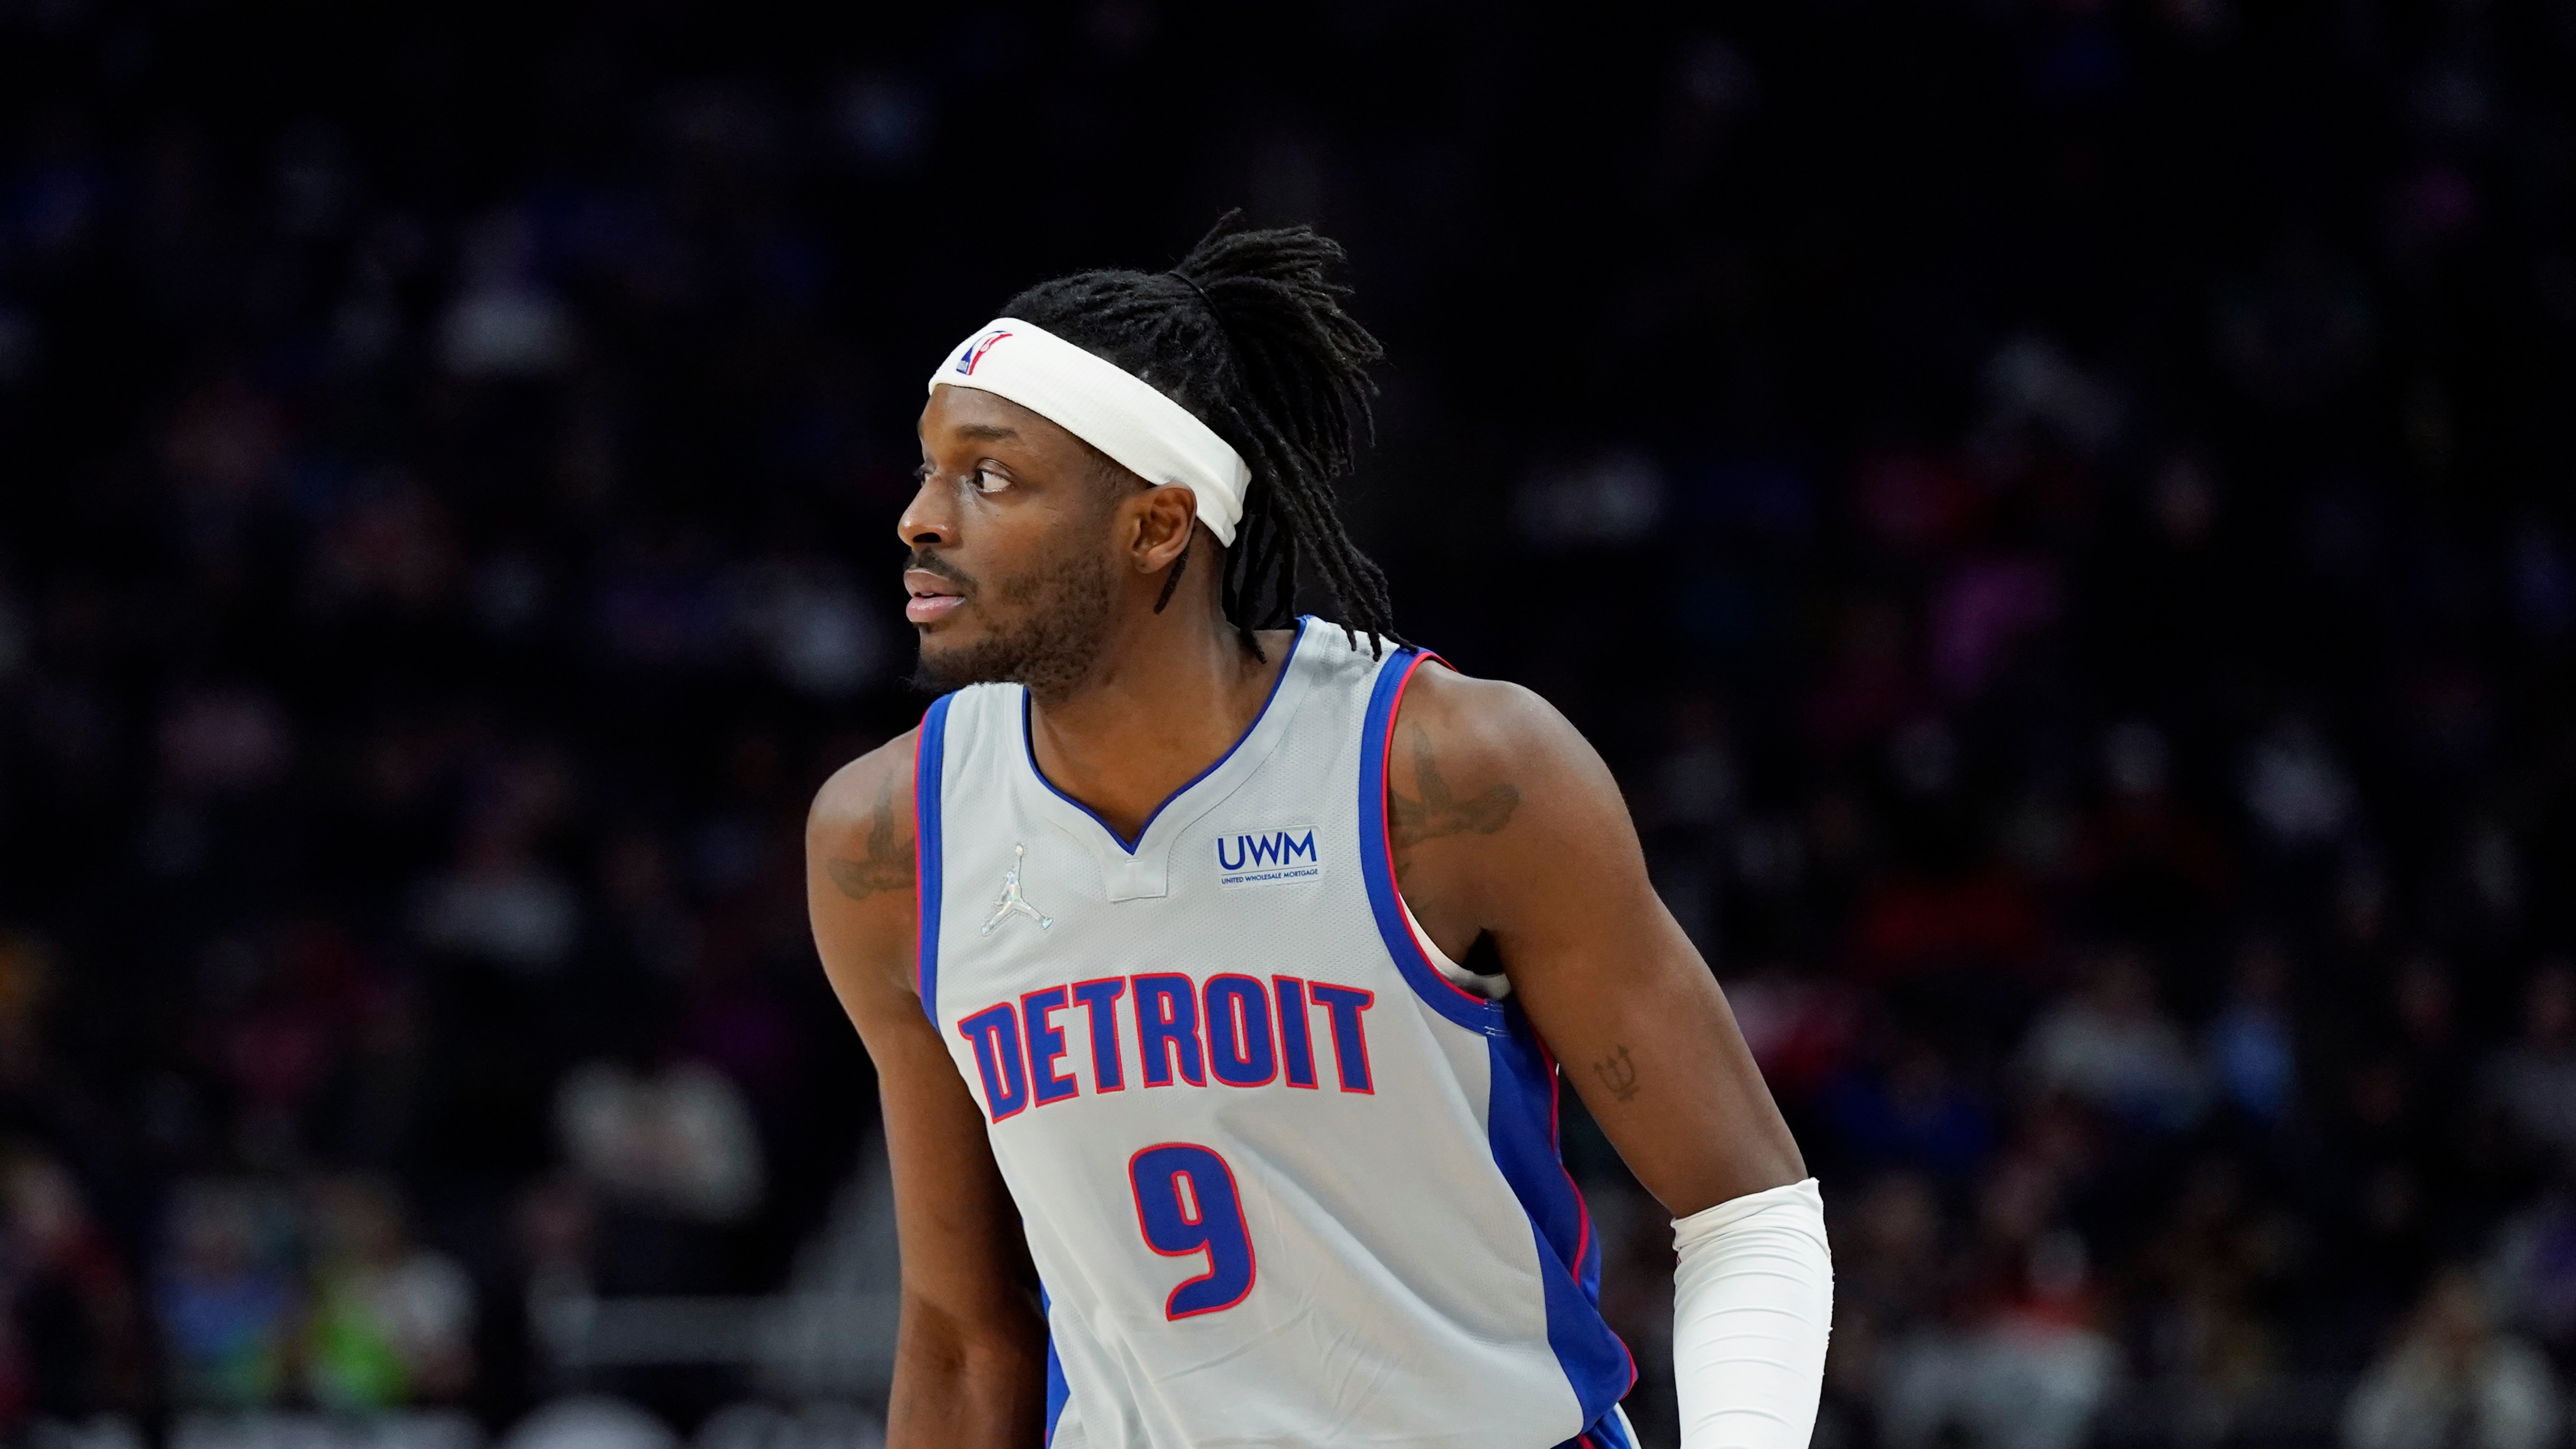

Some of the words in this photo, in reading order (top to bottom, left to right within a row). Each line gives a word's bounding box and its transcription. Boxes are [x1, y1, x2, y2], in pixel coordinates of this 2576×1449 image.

[1218, 830, 1317, 870] UWM
[1246, 873, 1282, 882] WHOLESALE
[1284, 869, 1318, 878] MORTGAGE
[957, 972, 1375, 1124] DETROIT
[1129, 1142, 1256, 1322] 9
